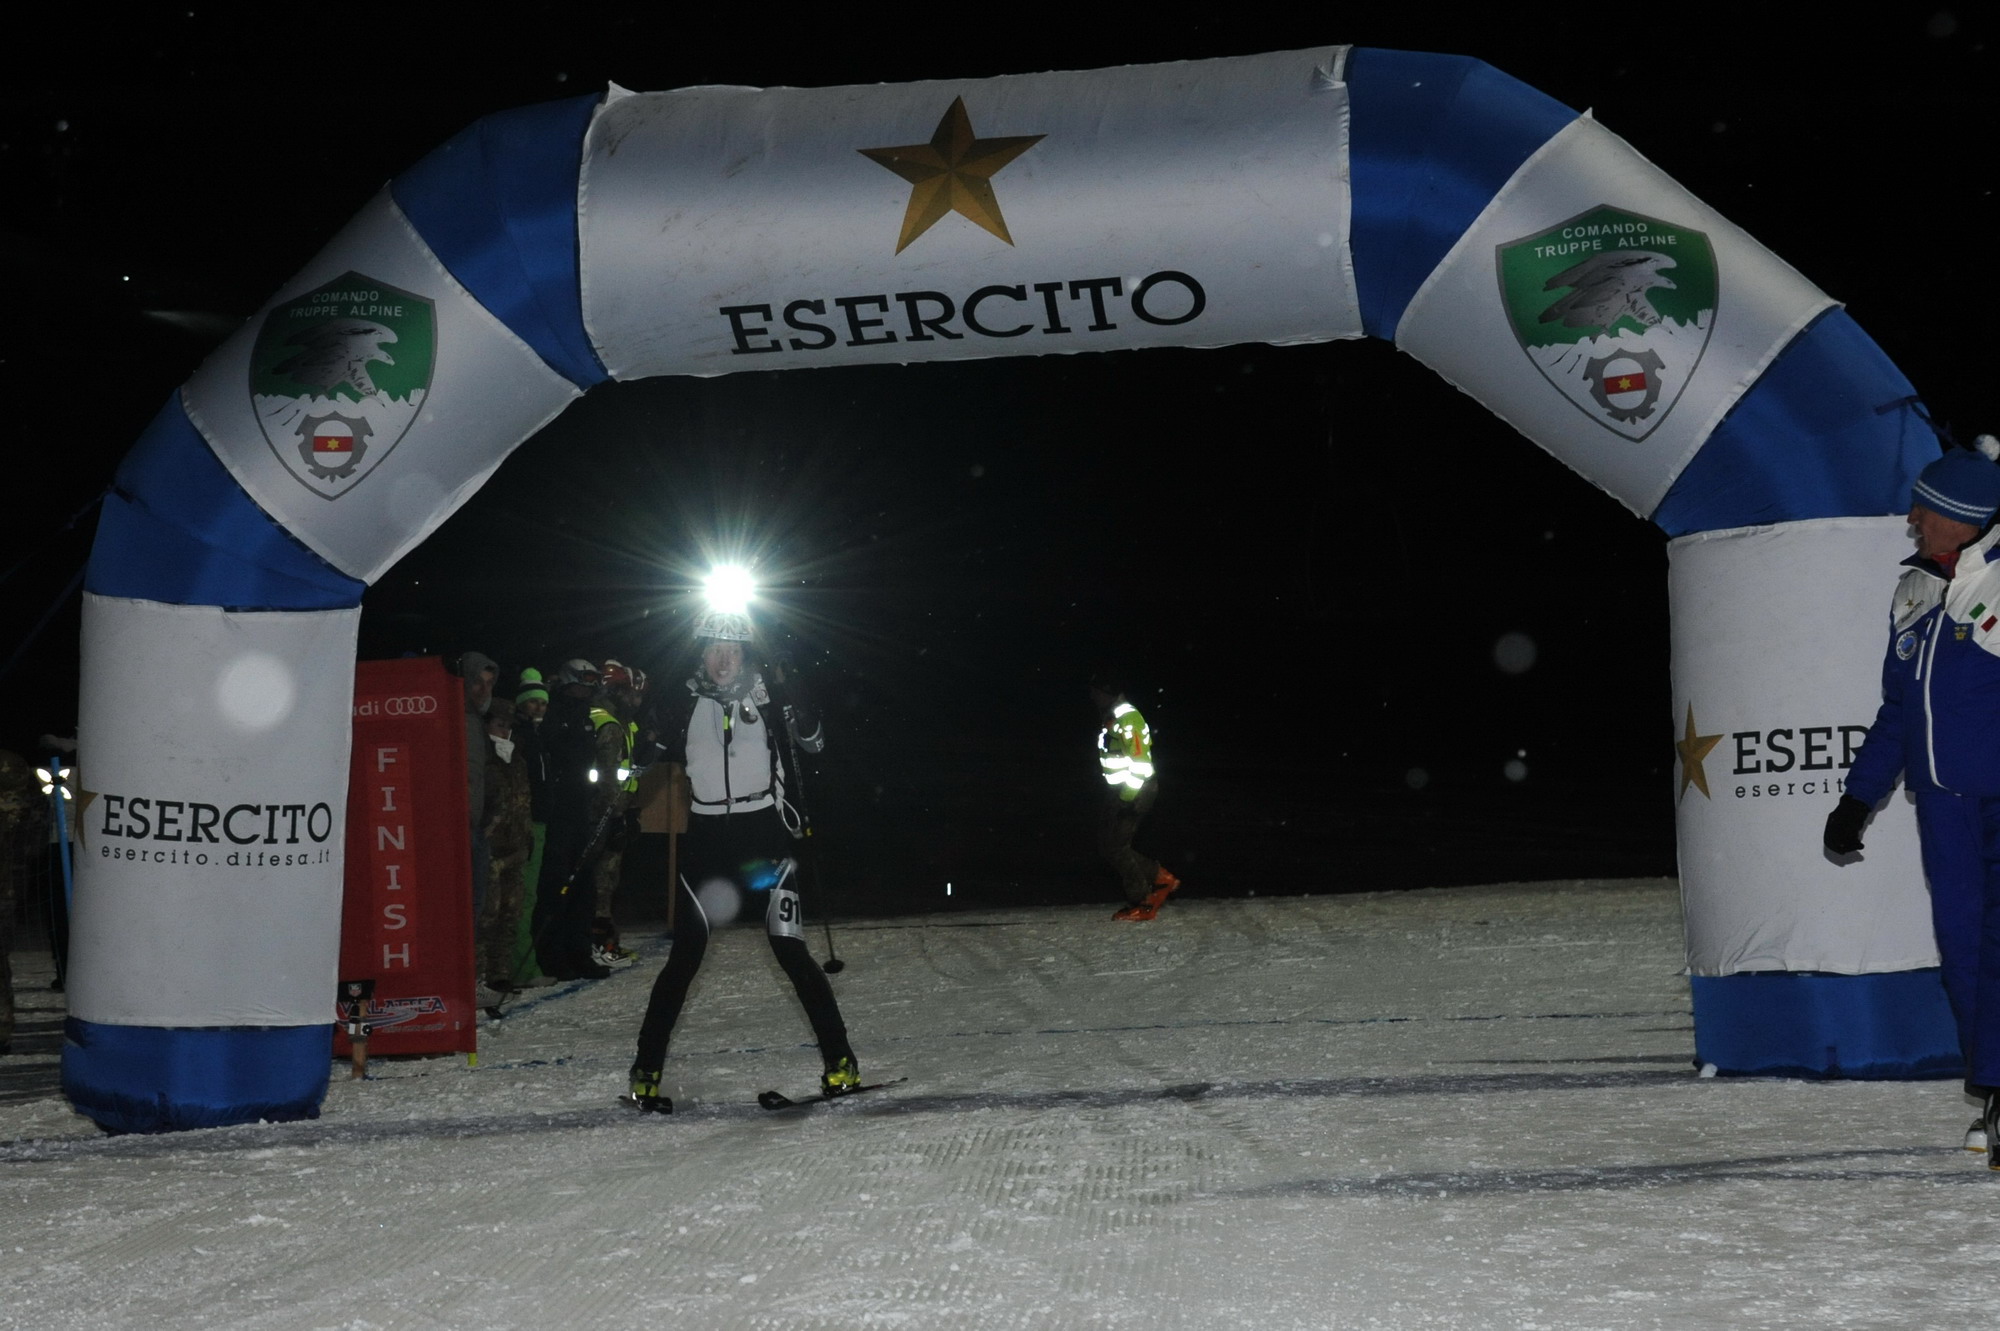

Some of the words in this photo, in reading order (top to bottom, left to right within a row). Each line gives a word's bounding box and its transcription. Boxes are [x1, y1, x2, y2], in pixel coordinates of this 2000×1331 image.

[1562, 222, 1648, 239] COMANDO
[1534, 238, 1602, 259] TRUPPE
[1618, 234, 1677, 248] ALPINE
[312, 290, 379, 304] COMANDO
[290, 305, 338, 318] TRUPPE
[350, 305, 403, 317] ALPINE
[719, 270, 1206, 355] ESERCITO
[101, 794, 332, 845] ESERCITO
[101, 845, 330, 867] esercito.difesa.it
[377, 747, 410, 969] FINISH
[779, 897, 800, 925] 91
